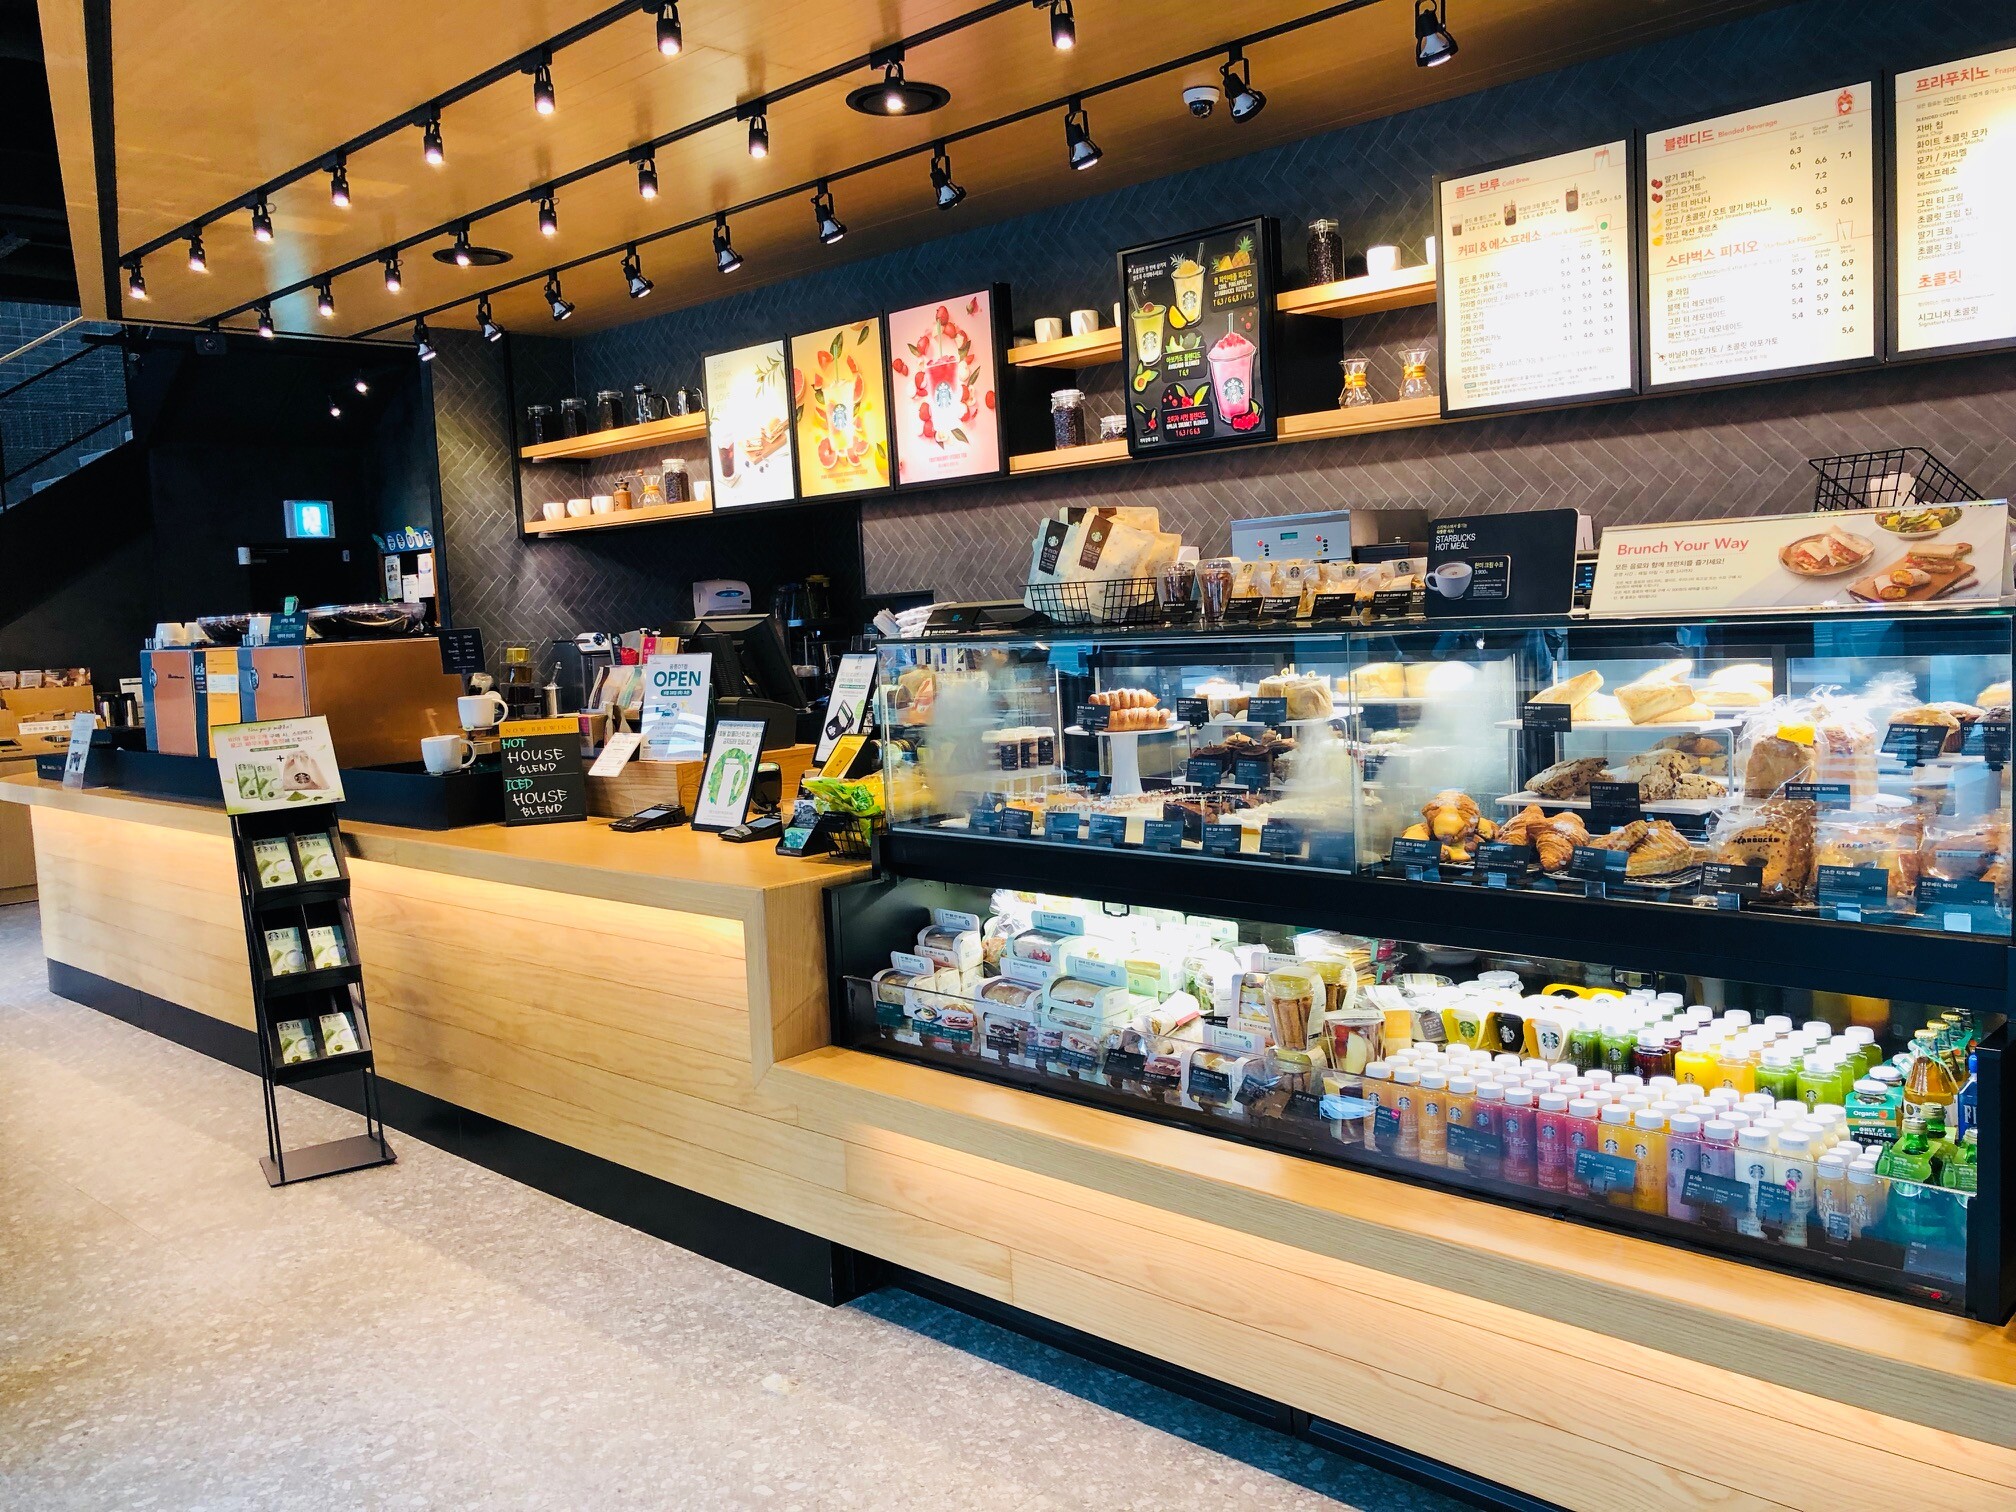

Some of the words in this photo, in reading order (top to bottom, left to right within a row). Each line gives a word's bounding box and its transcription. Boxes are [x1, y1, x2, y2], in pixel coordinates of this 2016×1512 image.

[1915, 66, 1990, 92] 프라푸치노
[1718, 126, 1745, 139] Blended
[1746, 119, 1778, 132] Beverage
[1916, 124, 1933, 134] 자바
[1934, 119, 1944, 132] 칩
[1664, 128, 1714, 153] 블렌디드
[1917, 138, 1941, 149] 화이트
[1944, 133, 1970, 145] 초콜릿
[1971, 127, 1988, 139] 모카
[1789, 146, 1802, 156] 6.3
[1789, 161, 1802, 171] 6.1
[1814, 156, 1828, 166] 6.6
[1840, 150, 1853, 160] 7.1
[1917, 155, 1934, 166] 모카
[1664, 172, 1679, 183] 딸기
[1815, 171, 1828, 181] 7.2
[1917, 166, 1958, 180] 에스프레소
[1455, 184, 1477, 200] 콜드
[1479, 177, 1500, 194] 브루
[1665, 188, 1679, 199] 딸기
[1815, 186, 1828, 196] 6.3
[1665, 202, 1679, 213] 그린
[1690, 195, 1711, 207] 바나나
[1790, 206, 1803, 216] 5.0
[1815, 201, 1829, 212] 5.5
[1840, 196, 1854, 206] 6.0
[1917, 197, 1933, 209] 그린
[1946, 191, 1964, 204] 크림
[1665, 216, 1679, 227] 망고
[1729, 204, 1744, 214] 딸기
[1746, 198, 1768, 211] 바나나
[1918, 230, 1935, 241] 딸기
[1937, 226, 1954, 238] 크림
[1458, 242, 1478, 257] 커피
[1489, 230, 1542, 251] 에스프레소
[1601, 248, 1611, 257] 7.1
[1665, 248, 1716, 268] 스타벅스
[1720, 239, 1759, 258] 피지오
[1601, 262, 1612, 271] 6.6
[1791, 267, 1804, 277] 5.9
[1816, 262, 1829, 273] 6.4
[1841, 258, 1855, 268] 6.9
[1602, 275, 1613, 284] 6.6
[1791, 281, 1804, 291] 5.4
[1816, 277, 1829, 287] 5.9
[1841, 273, 1855, 283] 6.4
[1918, 268, 1963, 289] 초콜릿
[1602, 288, 1613, 297] 6.1
[1792, 296, 1804, 306] 5.4
[1816, 292, 1829, 302] 5.9
[1841, 288, 1855, 298] 6.4
[1603, 301, 1614, 310] 5.6
[1792, 311, 1804, 321] 5.4
[1816, 307, 1829, 317] 5.9
[1842, 303, 1855, 313] 6.4
[1603, 314, 1614, 323] 5.1
[1918, 310, 1952, 322] 시그니처
[1954, 305, 1980, 318] 초콜릿
[1604, 328, 1614, 337] 5.1
[1842, 325, 1855, 335] 5.6
[1435, 532, 1476, 545] STARBUCKS
[1435, 543, 1449, 551] HOT
[1450, 541, 1470, 551] MEAL
[1617, 541, 1668, 556] Brunch
[1673, 540, 1710, 553] Your
[1714, 537, 1750, 556] Way
[1614, 563, 1628, 572] 모든
[654, 670, 702, 688] OPEN
[505, 727, 526, 735] NOW
[531, 724, 574, 733] BREWING
[502, 738, 527, 750] HOT
[507, 748, 566, 764] HOUSE
[516, 762, 557, 775] BLEND
[504, 778, 535, 793] ICED
[512, 788, 568, 807] HOUSE
[520, 803, 563, 818] BLEND
[1853, 1109, 1879, 1118] Organic
